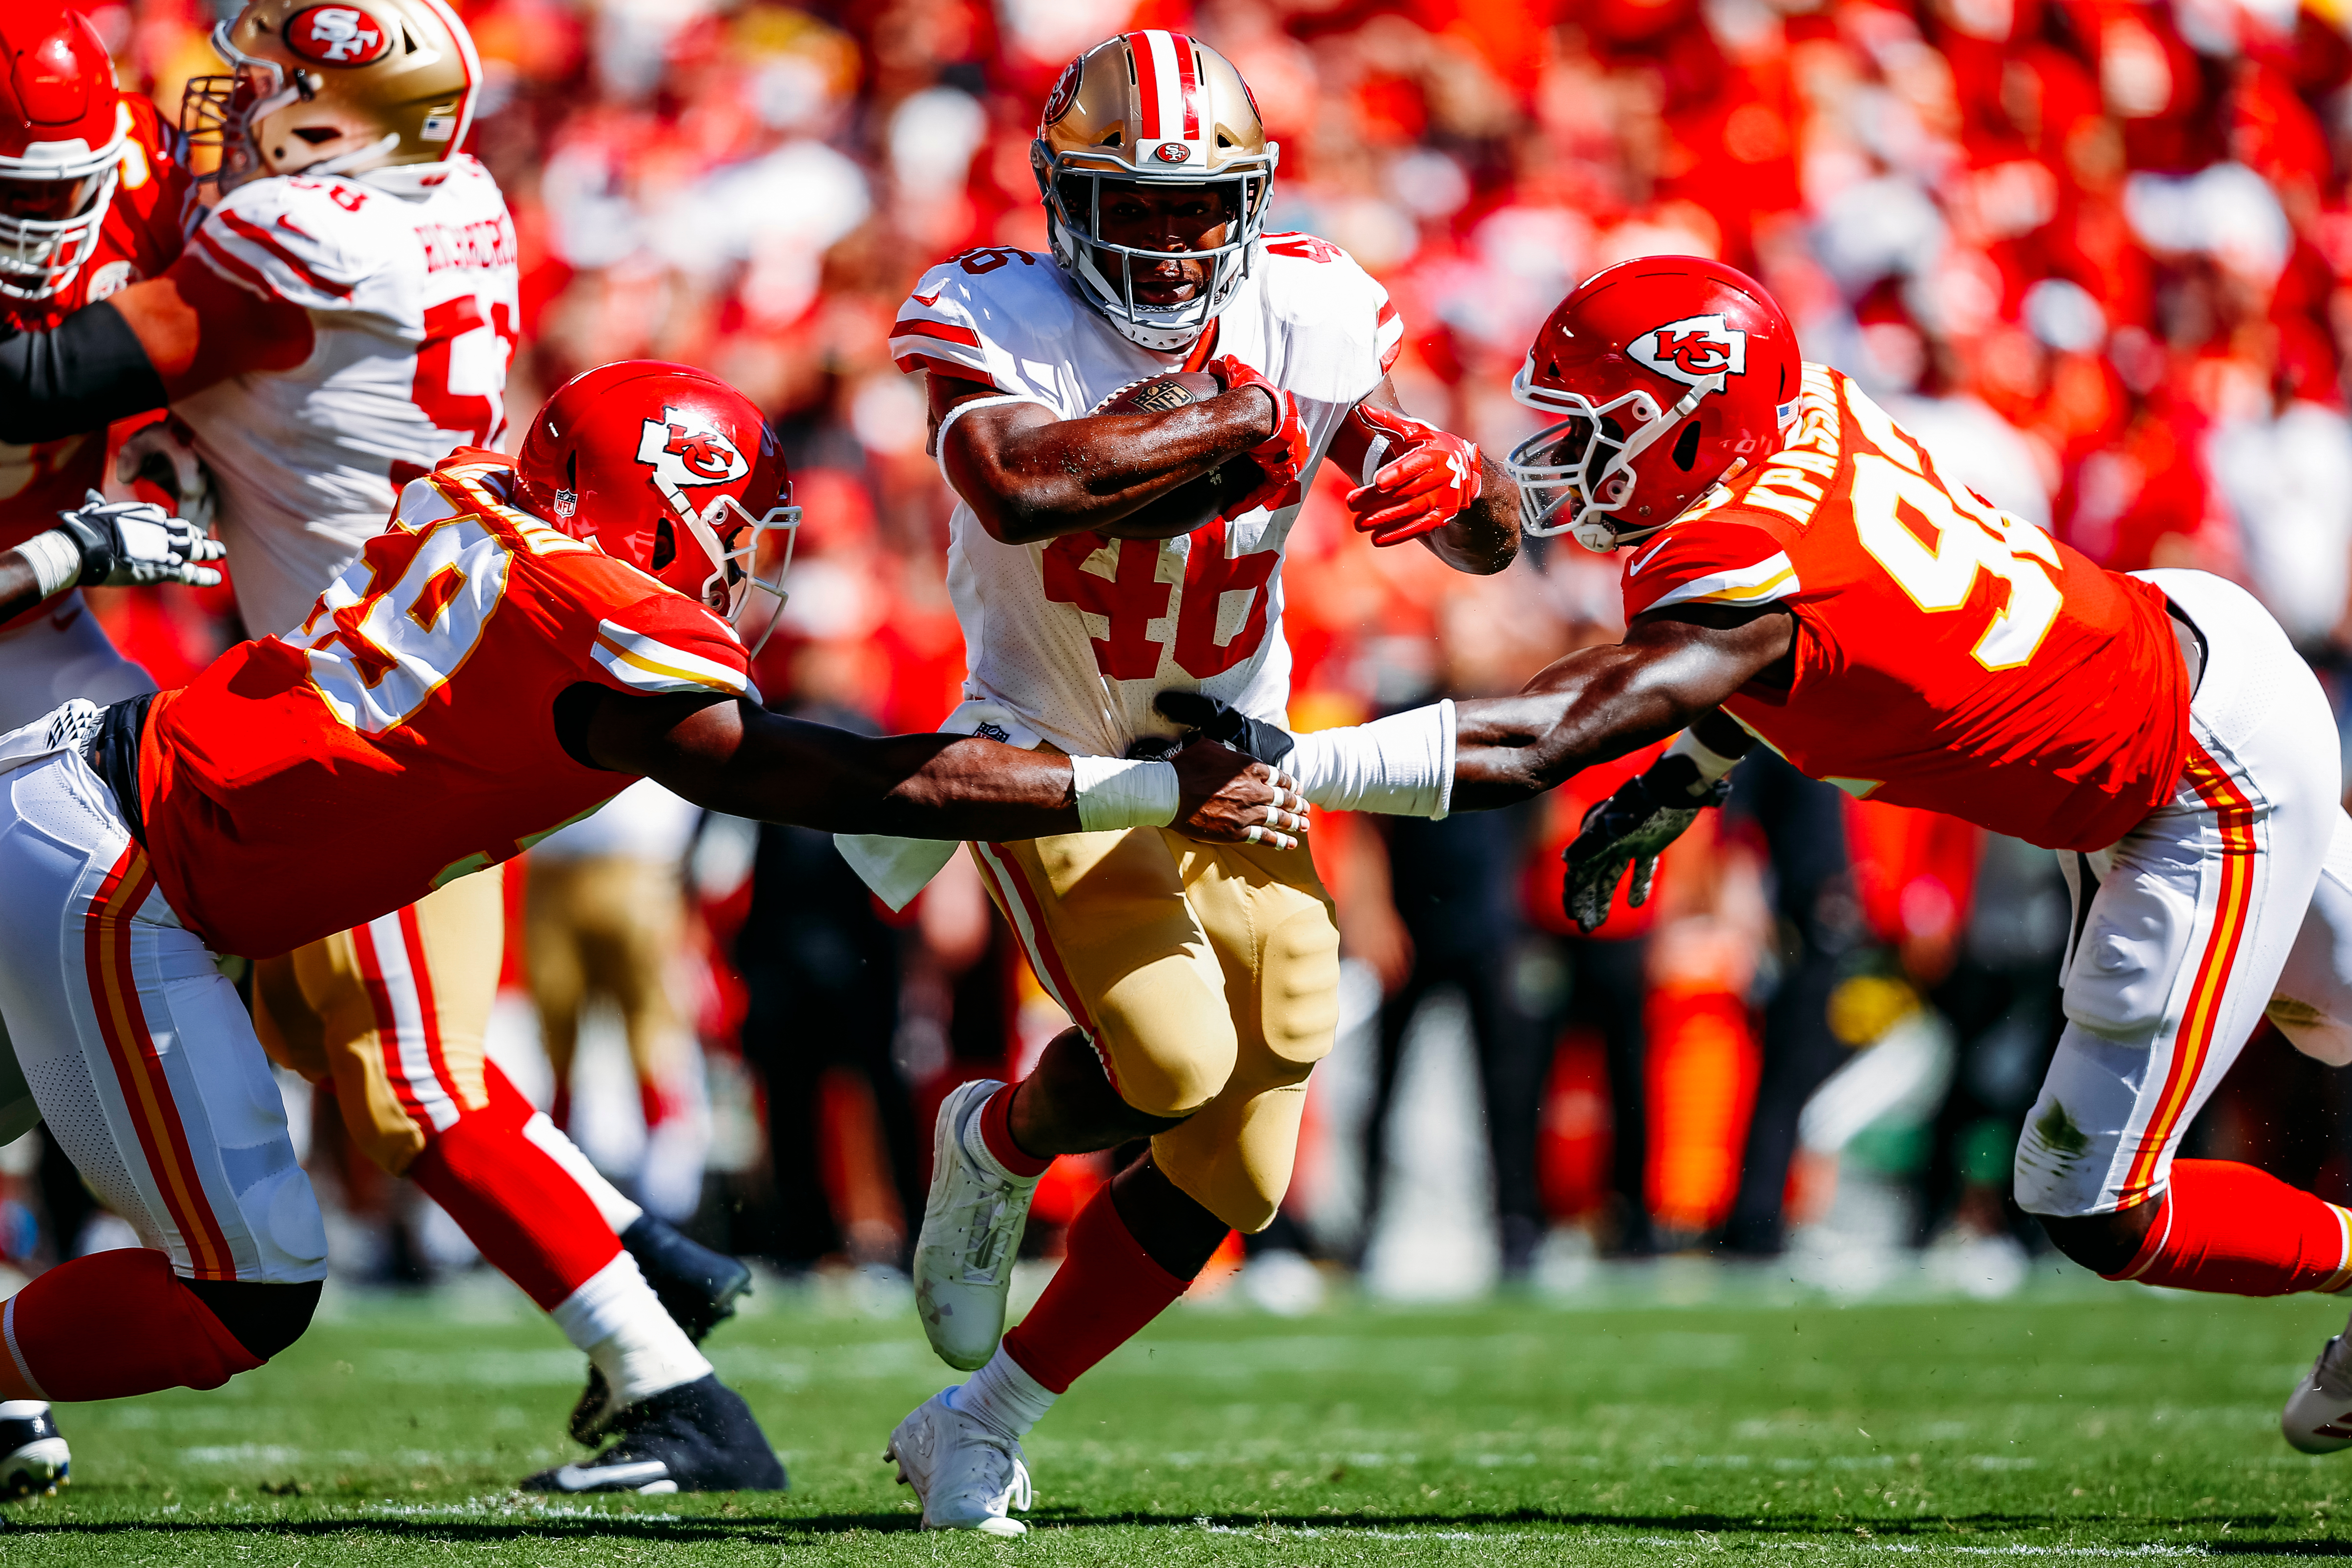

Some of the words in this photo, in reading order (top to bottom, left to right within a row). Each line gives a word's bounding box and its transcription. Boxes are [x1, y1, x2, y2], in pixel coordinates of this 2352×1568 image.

[311, 8, 379, 61] SF
[1165, 144, 1185, 161] SF
[1653, 330, 1730, 376] KC
[1144, 386, 1190, 412] NFL
[663, 423, 734, 480] KC
[557, 500, 573, 513] NFL
[1042, 481, 1302, 681] 46
